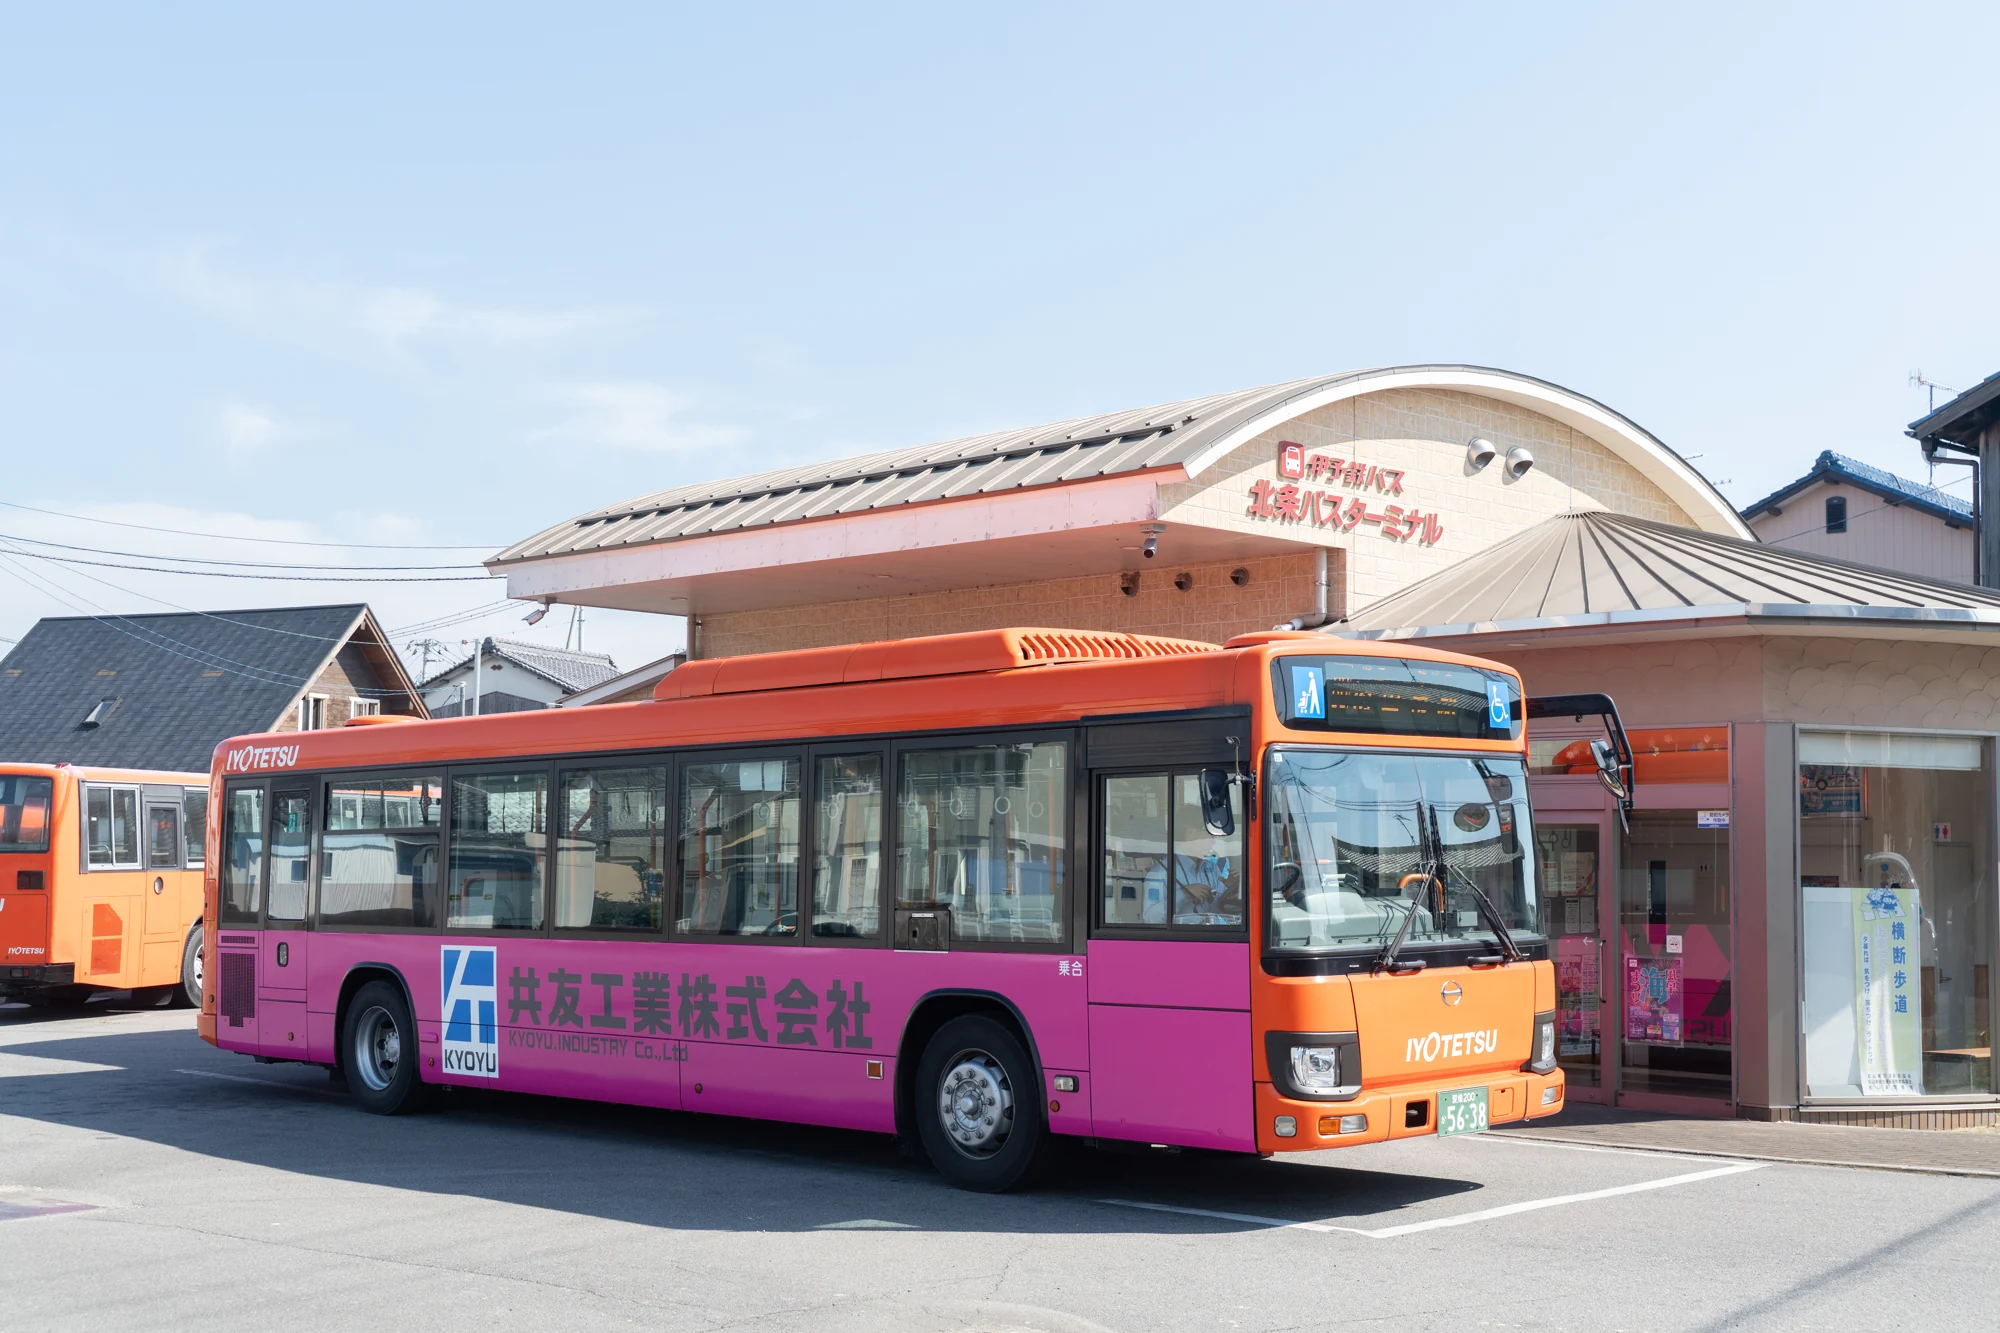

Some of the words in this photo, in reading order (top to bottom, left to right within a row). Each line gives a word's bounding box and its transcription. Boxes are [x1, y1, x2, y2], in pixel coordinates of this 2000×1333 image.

[1307, 453, 1406, 494] 伊予鉄バス
[1249, 478, 1444, 545] 北条バスターミナル
[226, 744, 300, 772] IYOTETSU
[8, 946, 45, 955] IYOTETSU
[1892, 921, 1907, 1014] 横断歩道
[1058, 960, 1083, 977] 乗合
[508, 965, 873, 1050] 共友工業株式会社
[444, 1048, 497, 1073] KYOYU
[1405, 1029, 1498, 1063] IYOTETSU
